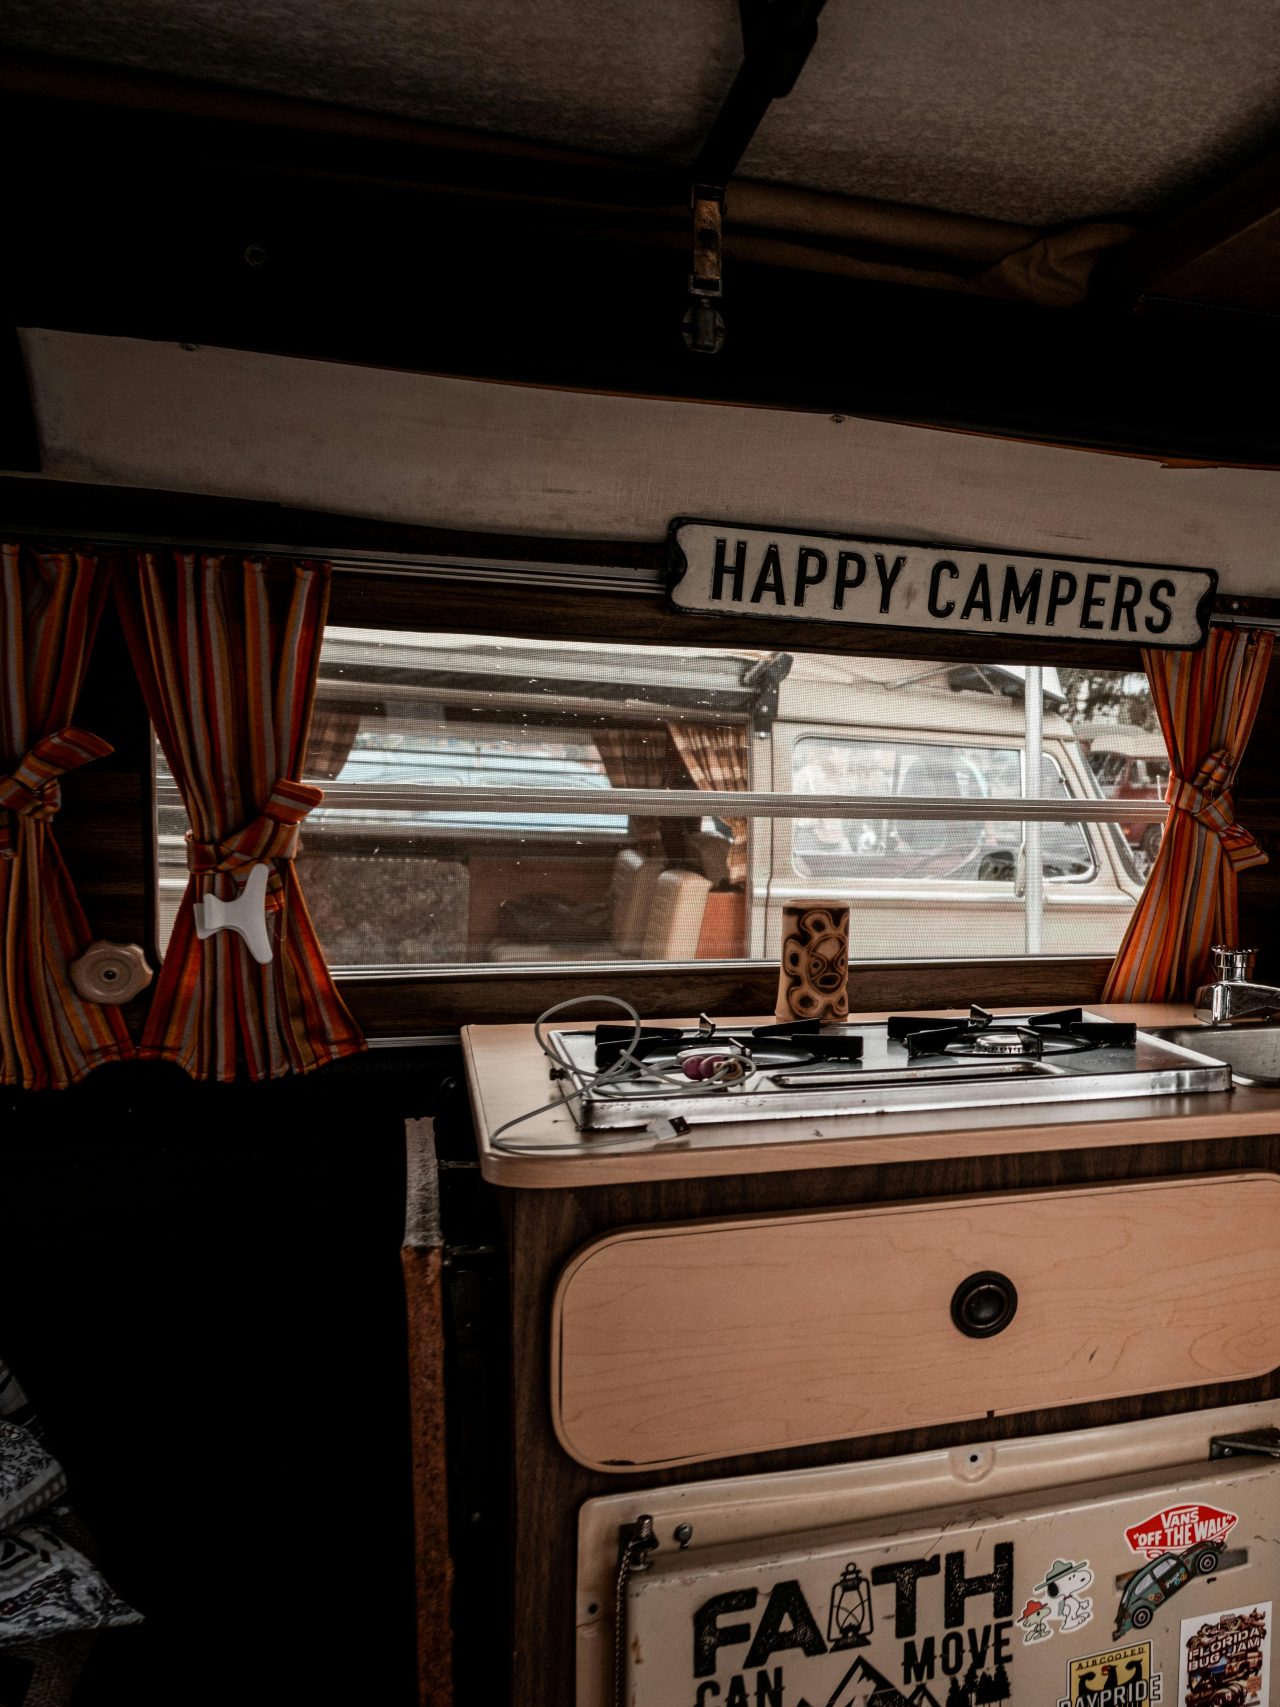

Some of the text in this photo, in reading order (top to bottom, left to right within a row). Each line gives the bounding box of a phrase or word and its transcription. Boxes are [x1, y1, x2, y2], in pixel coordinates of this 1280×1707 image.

[711, 538, 1176, 634] HAPPY CAMPERS
[1161, 1506, 1199, 1529] VANS
[1165, 1524, 1192, 1546] THE
[902, 1620, 1014, 1685] MOVE
[1075, 1647, 1145, 1671] AIRCOOLED
[1188, 1637, 1260, 1671] BUG JAM
[1189, 1627, 1260, 1660] FLORIDA
[696, 1666, 784, 1707] CAN
